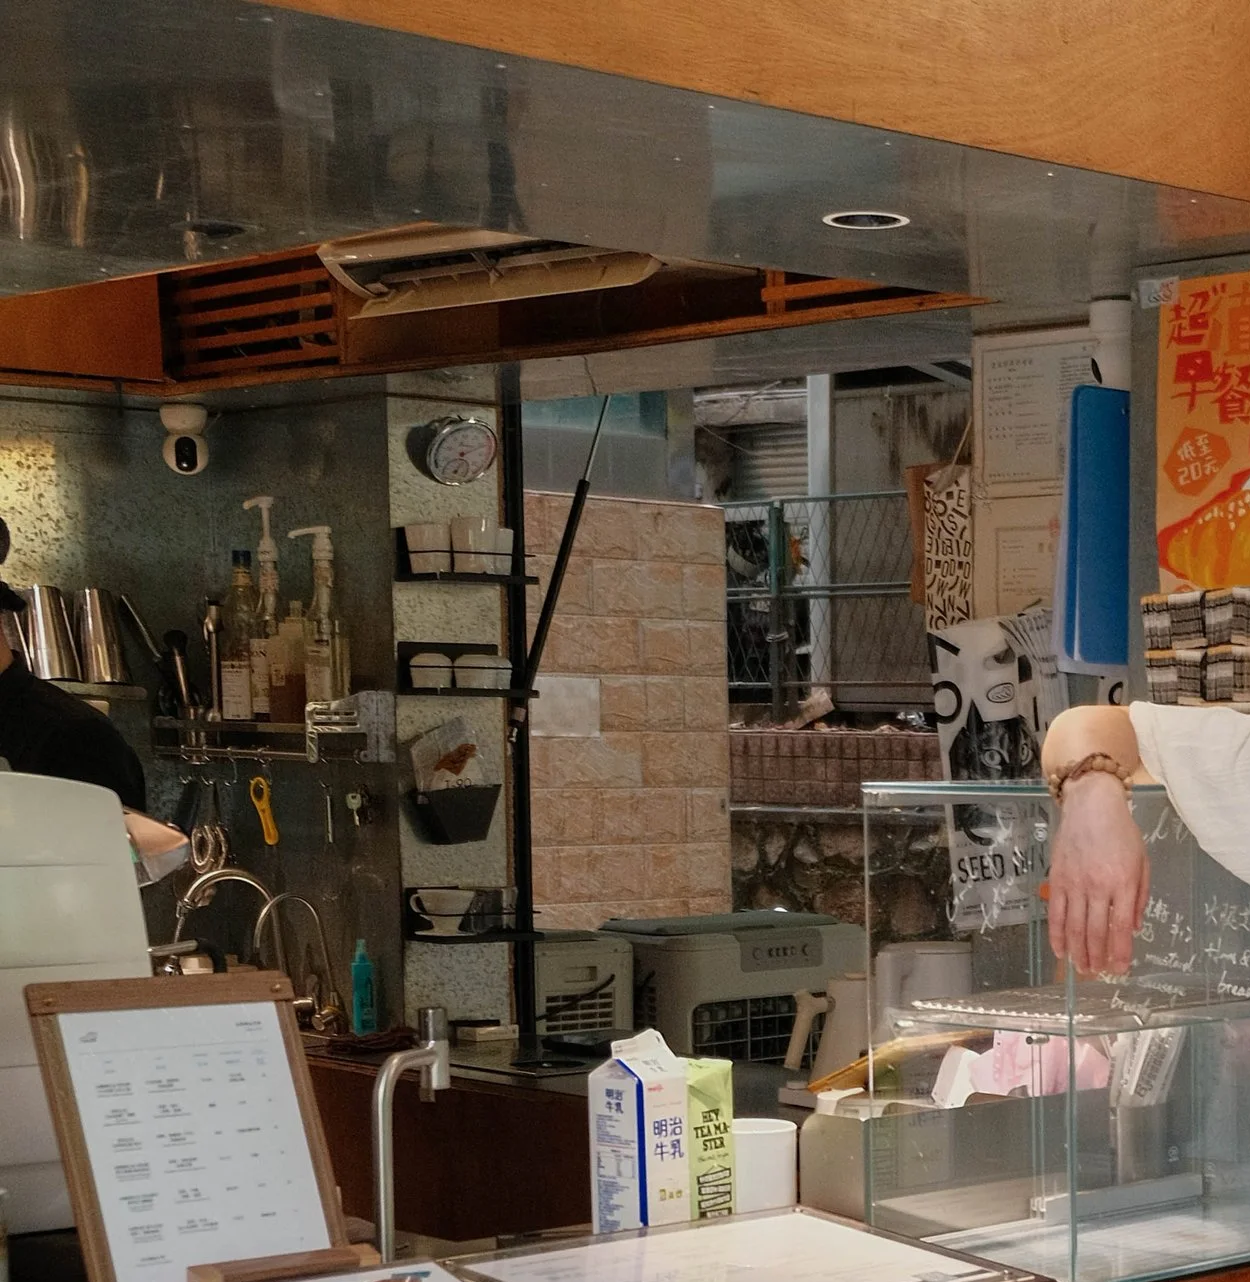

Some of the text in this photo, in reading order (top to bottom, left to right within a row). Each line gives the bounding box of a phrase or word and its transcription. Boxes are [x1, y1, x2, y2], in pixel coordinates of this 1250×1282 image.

[957, 852, 1005, 885] SEED
[605, 1088, 624, 1102] 明治
[605, 1101, 624, 1115] 牛乳
[701, 1107, 721, 1123] HEY
[653, 1116, 684, 1138] 明治
[693, 1123, 714, 1140] TEA
[653, 1139, 685, 1162] 牛乳
[702, 1135, 725, 1152] STER
